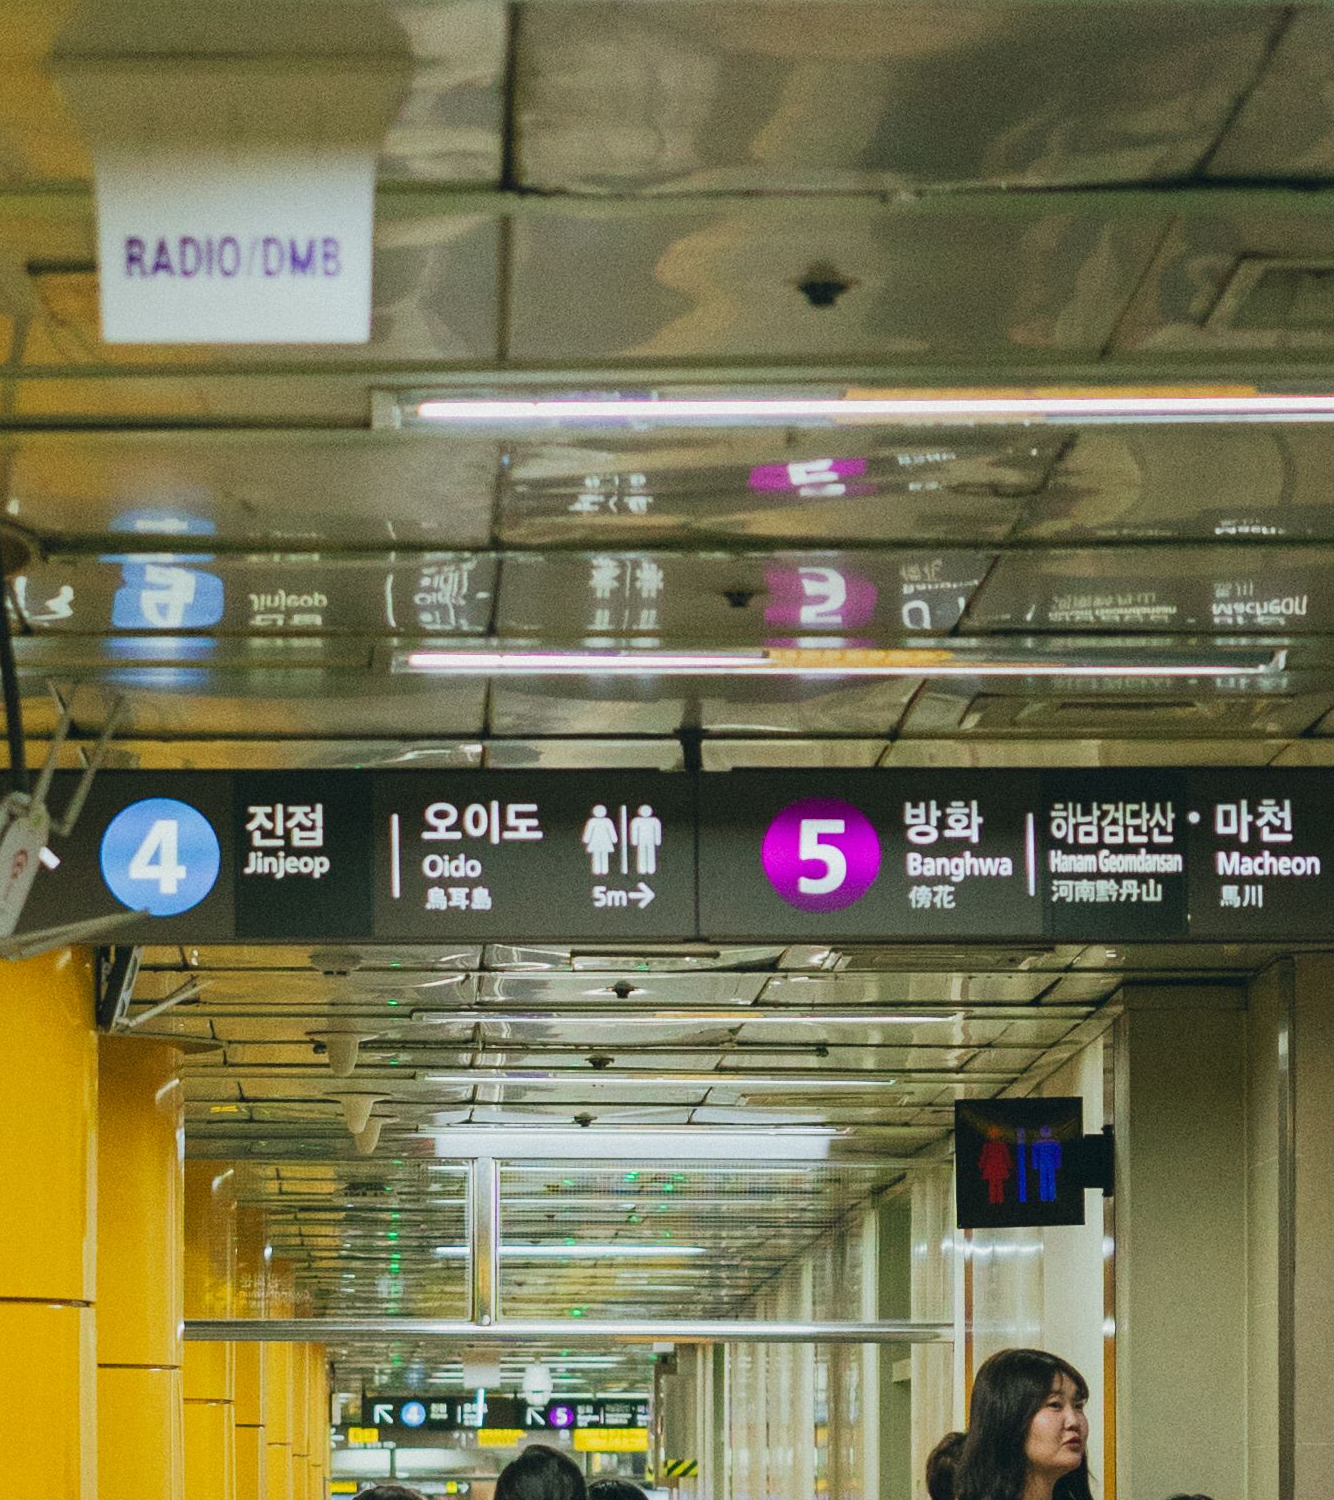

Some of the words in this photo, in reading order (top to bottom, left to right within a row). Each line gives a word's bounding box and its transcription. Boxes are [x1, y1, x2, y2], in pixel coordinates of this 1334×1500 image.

[245, 803, 324, 848] 진접
[421, 800, 544, 845] 오이도
[904, 799, 984, 845] 방화
[1050, 801, 1176, 845] 하남검단산
[1215, 799, 1293, 844] 마천
[128, 818, 187, 895] 4
[243, 850, 331, 880] Jinjeop
[422, 853, 482, 879] Oido
[797, 818, 848, 895] 5
[906, 850, 1013, 880] Banghwa
[1049, 849, 1098, 873] Hanam
[1097, 847, 1183, 874] Geomdansan
[1216, 849, 1321, 876] Macheon
[592, 885, 628, 908] 5m
[1219, 884, 1264, 908] 馬川
